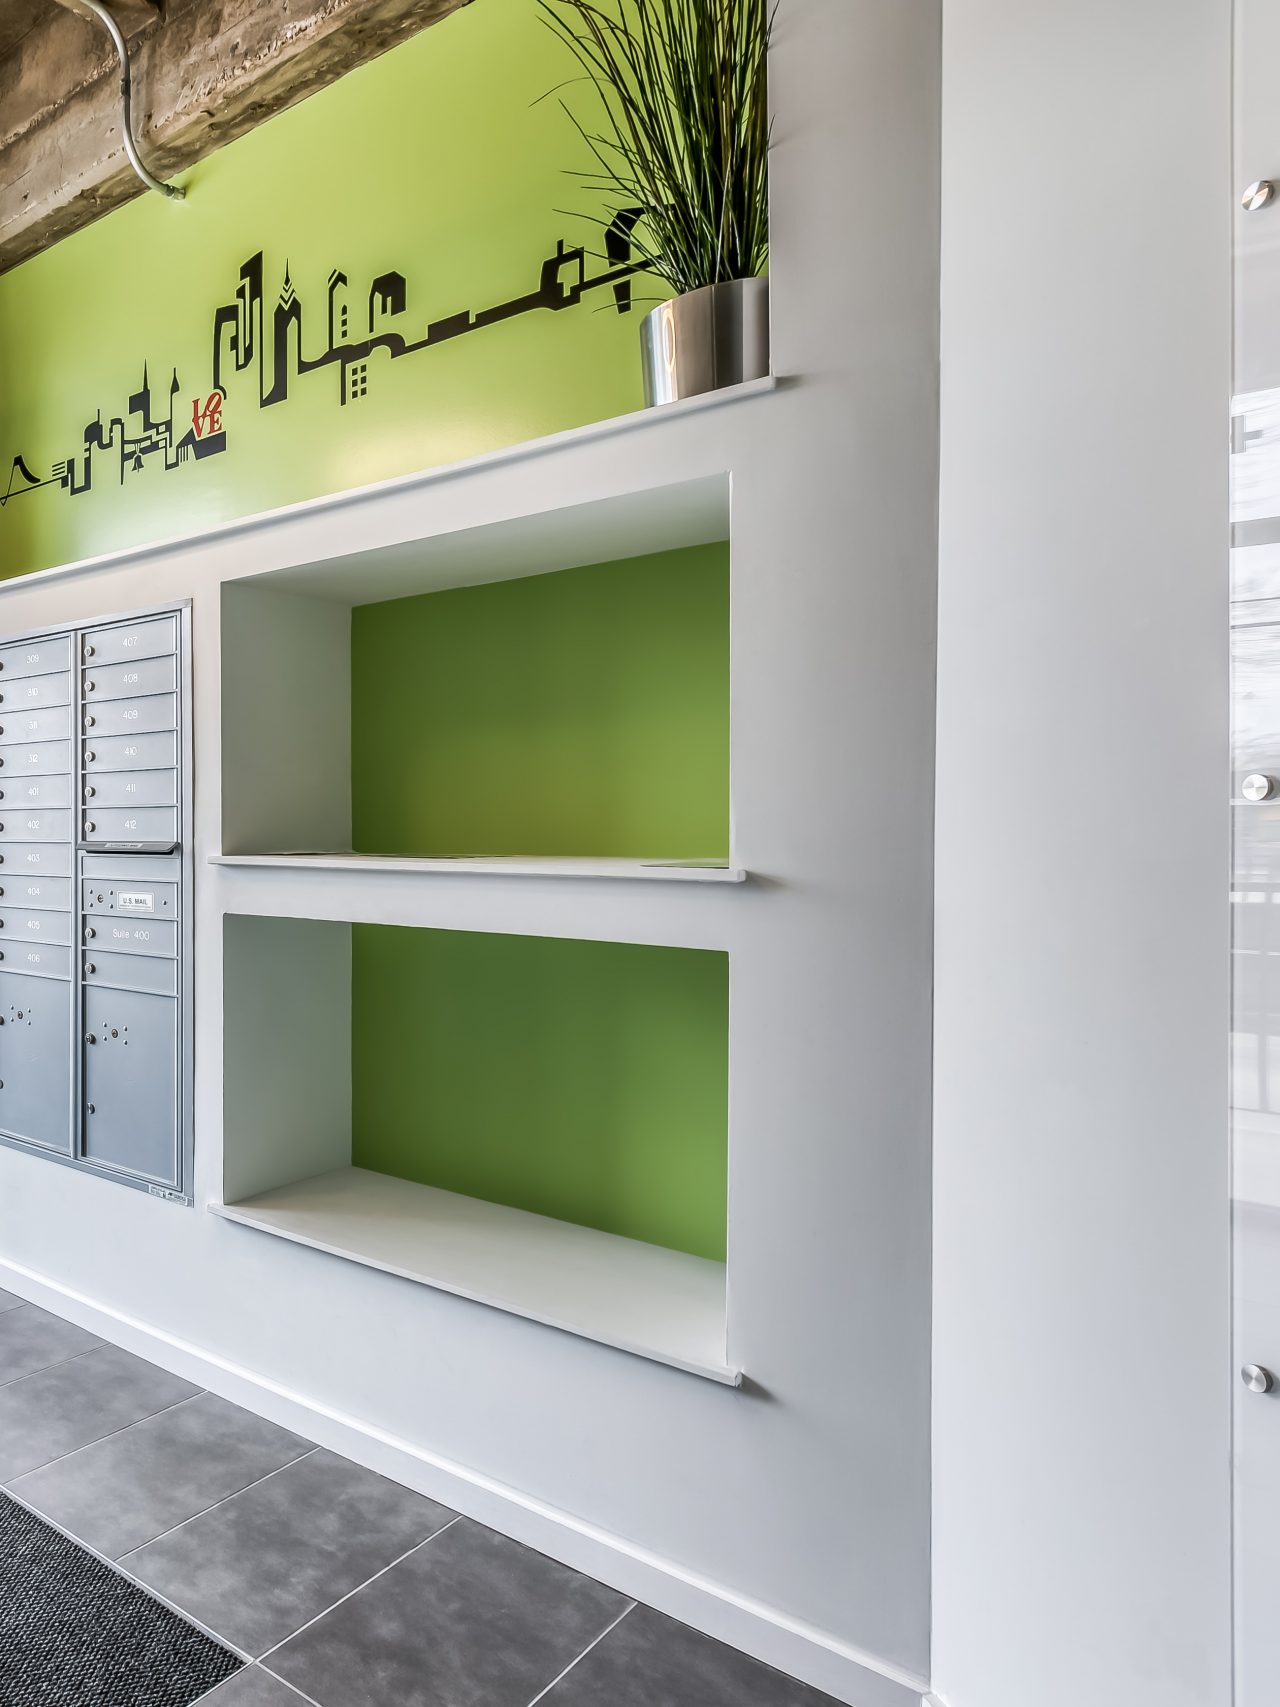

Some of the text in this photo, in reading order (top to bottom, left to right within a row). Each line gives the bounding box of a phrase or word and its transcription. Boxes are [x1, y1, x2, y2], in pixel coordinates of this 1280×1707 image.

[191, 391, 223, 438] LOVE
[122, 636, 138, 648] 407
[26, 653, 40, 664] 309
[122, 672, 139, 684] 408
[27, 687, 39, 698] 310
[122, 709, 139, 720] 409
[28, 720, 38, 730] 311
[124, 745, 138, 756] 410
[28, 753, 39, 763] 312
[27, 786, 40, 797] 401
[125, 783, 136, 793] 411
[27, 819, 41, 830] 402
[124, 819, 137, 830] 412
[26, 853, 41, 863] 403
[27, 886, 41, 897] 404
[134, 897, 149, 906] MAIL
[27, 920, 41, 930] 405
[112, 927, 151, 942] Suite 400
[27, 953, 41, 964] 406
